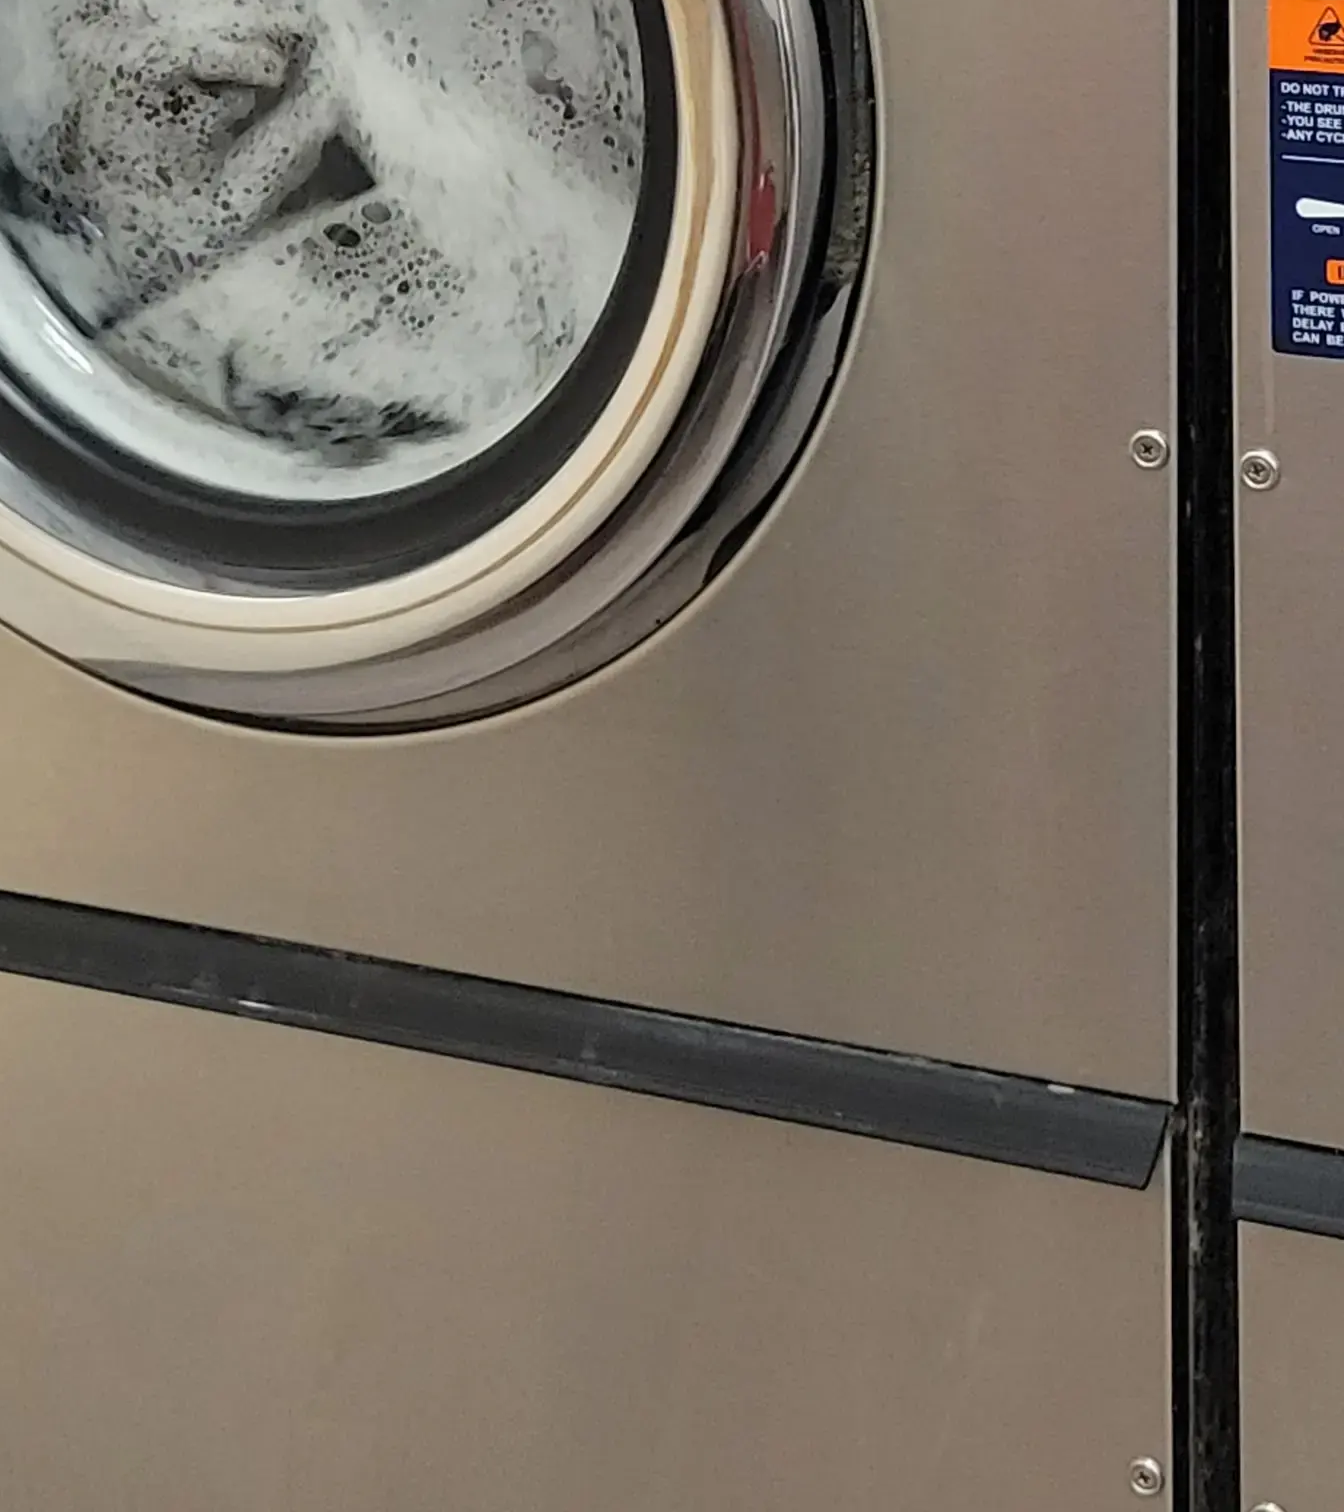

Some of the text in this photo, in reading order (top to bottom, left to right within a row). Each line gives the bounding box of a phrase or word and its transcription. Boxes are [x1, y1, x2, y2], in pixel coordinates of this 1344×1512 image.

[1280, 81, 1302, 95] DO
[1303, 82, 1331, 97] NOT
[1281, 100, 1313, 115] -THE
[1281, 114, 1315, 129] -YOU
[1316, 116, 1343, 131] SEE
[1281, 129, 1314, 142] -ANY
[1311, 223, 1341, 236] OPEN
[1291, 289, 1305, 302] IF
[1291, 302, 1336, 319] THERE
[1291, 316, 1335, 332] DELAY
[1292, 330, 1321, 345] CAN
[1325, 333, 1344, 349] BE
